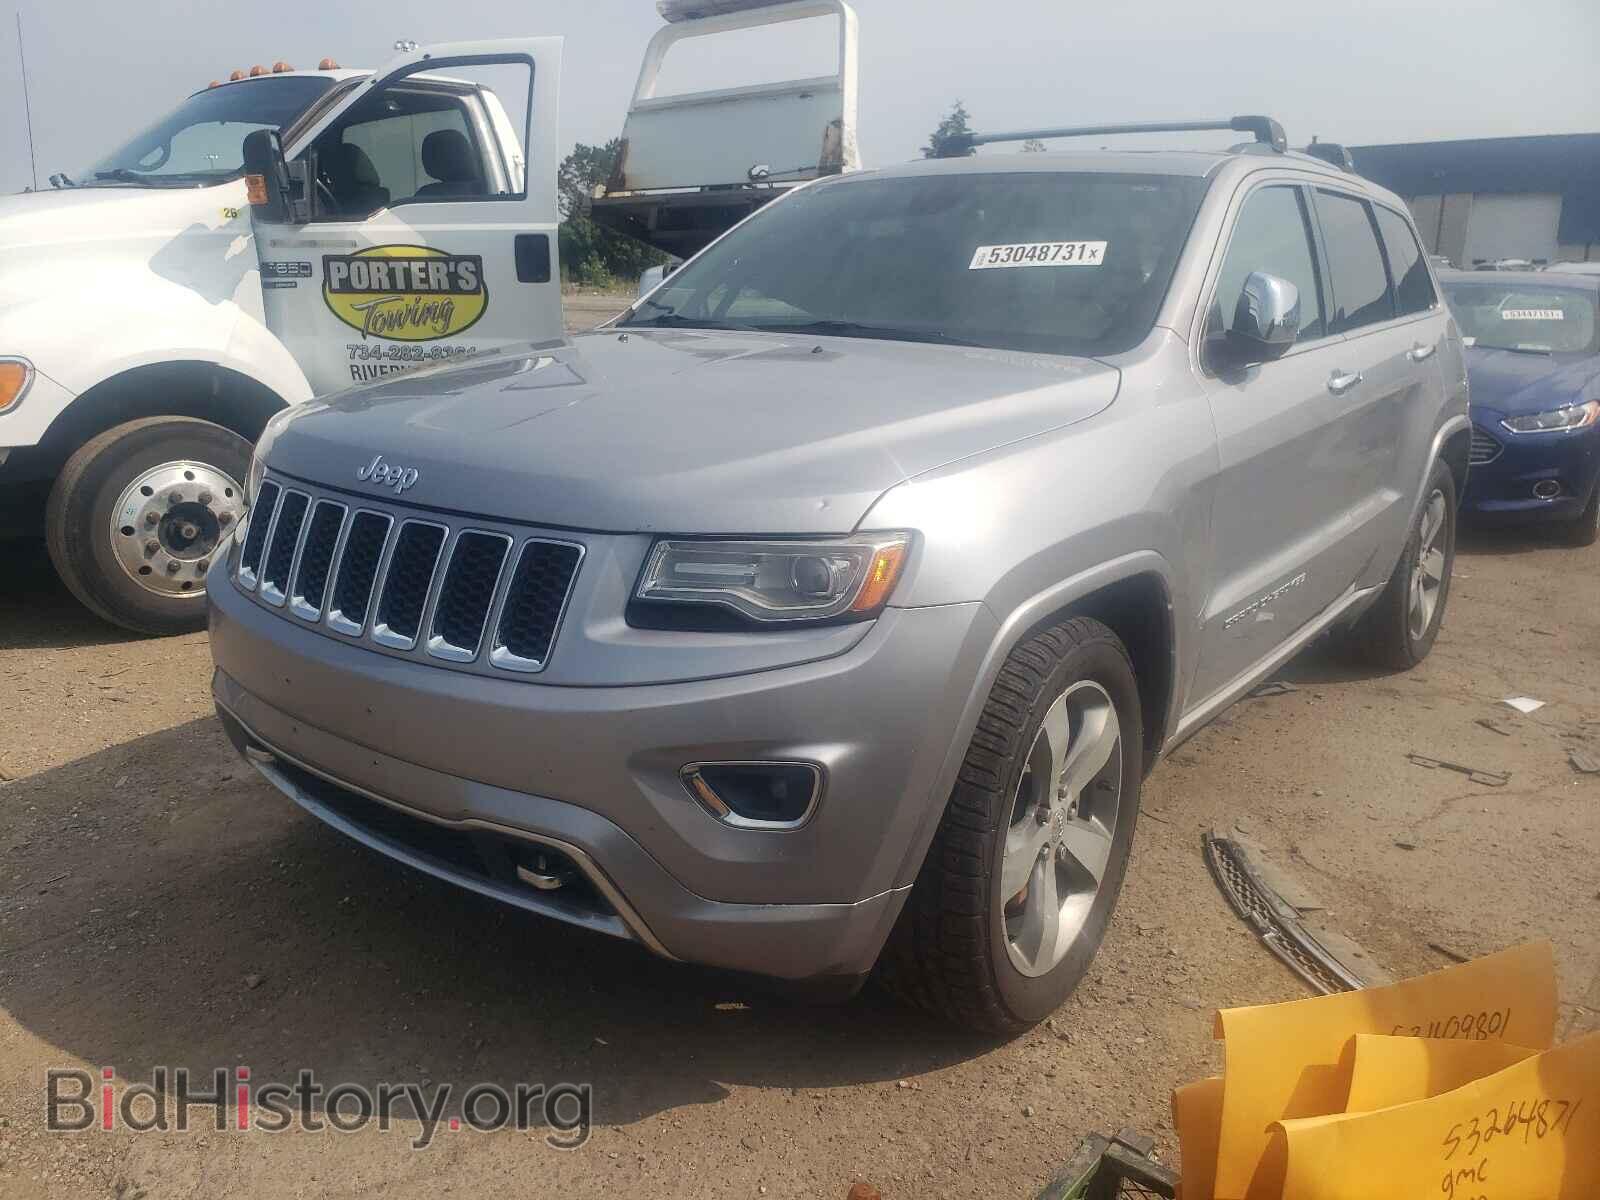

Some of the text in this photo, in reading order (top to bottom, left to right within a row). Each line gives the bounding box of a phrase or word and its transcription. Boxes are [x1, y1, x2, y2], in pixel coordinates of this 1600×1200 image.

[988, 243, 1087, 264] 53048731
[329, 261, 478, 291] PORTER'S
[351, 296, 455, 340] Towing
[357, 455, 419, 495] Jeep
[1442, 1098, 1583, 1160] 53264871
